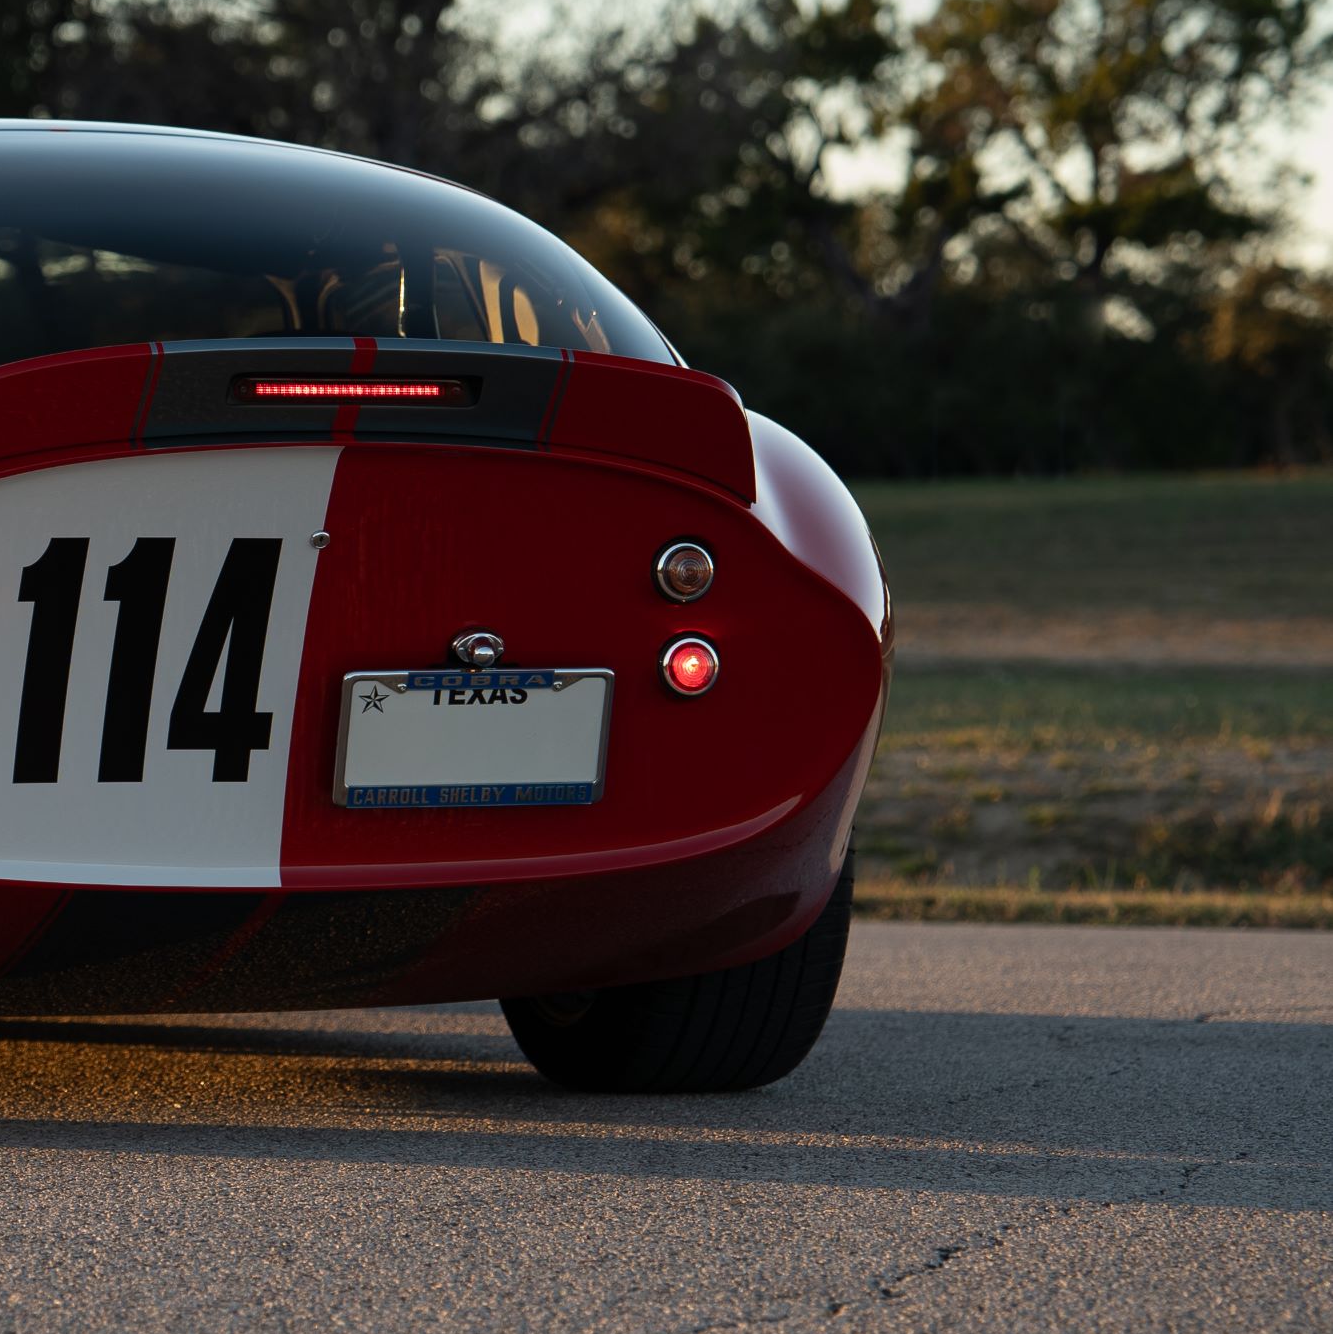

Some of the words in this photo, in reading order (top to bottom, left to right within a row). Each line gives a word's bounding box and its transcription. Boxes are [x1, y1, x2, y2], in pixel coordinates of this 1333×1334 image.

[12, 537, 284, 784] 114
[413, 674, 547, 687] COBRA
[433, 688, 528, 705] TEXAS
[353, 787, 429, 805] CARROLL
[439, 786, 506, 804] SHELBY
[515, 785, 587, 802] MOTORS
